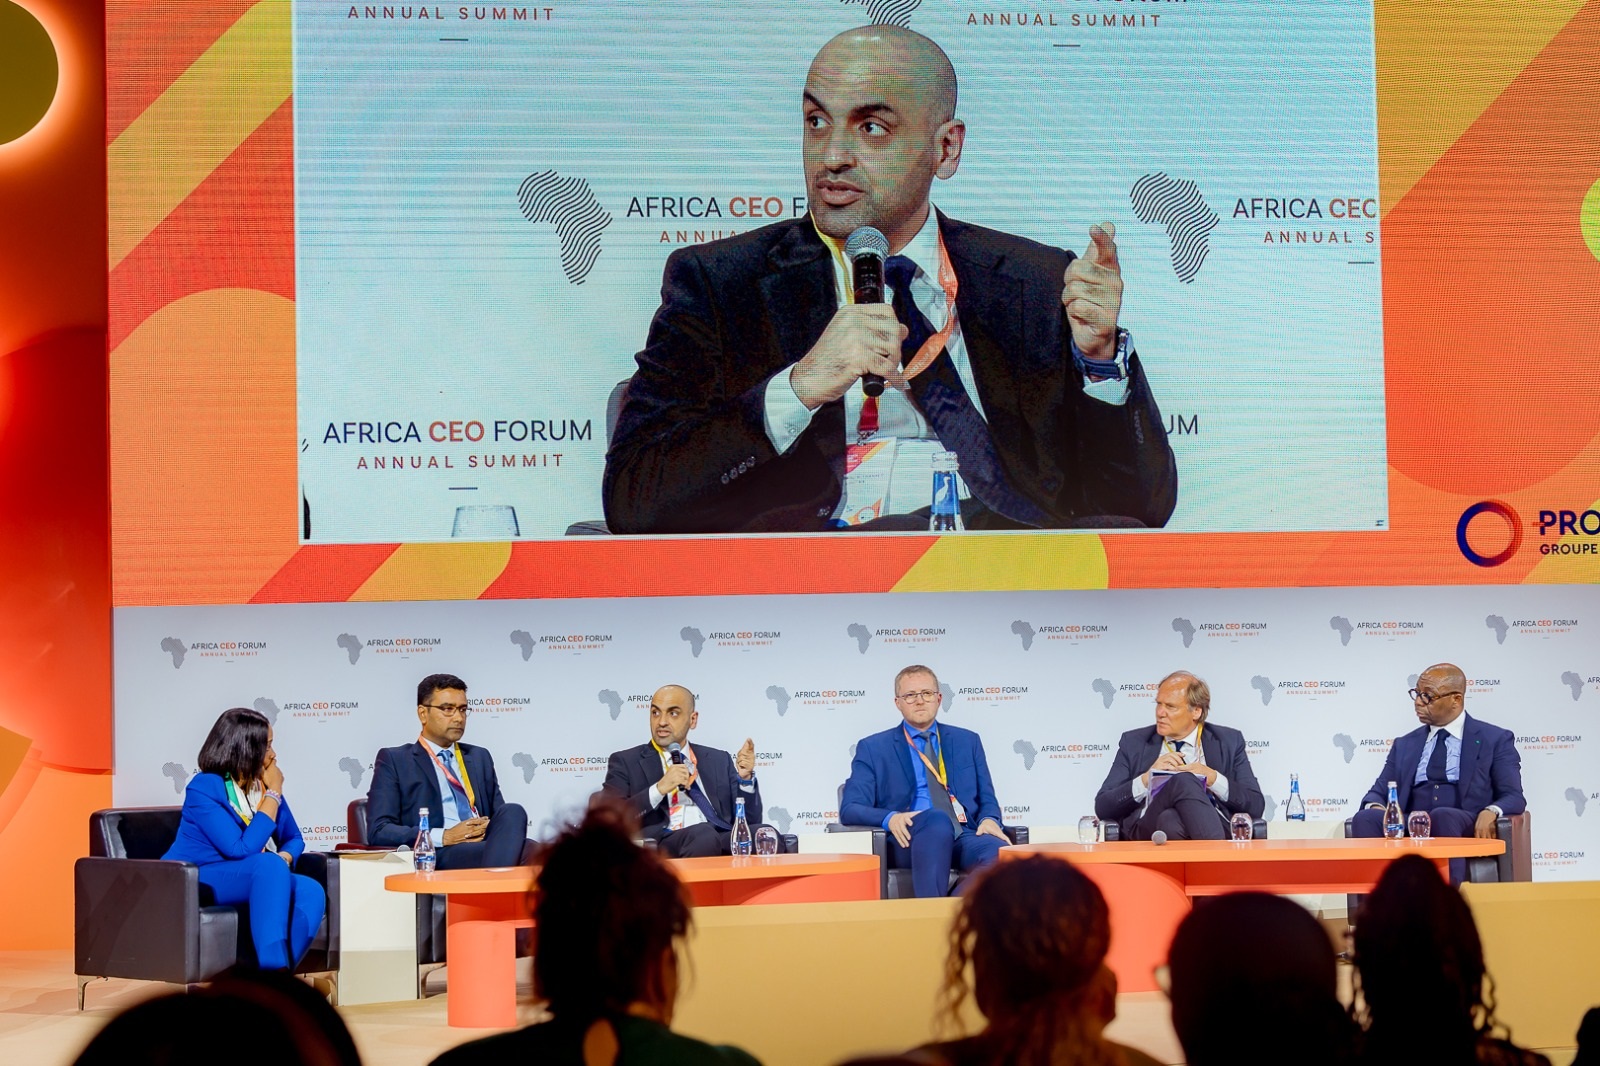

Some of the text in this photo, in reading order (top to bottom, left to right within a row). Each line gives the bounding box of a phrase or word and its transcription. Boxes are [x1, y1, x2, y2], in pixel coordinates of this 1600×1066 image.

[348, 6, 554, 20] ANNUAL SUMMIT
[967, 13, 1160, 27] ANNUAL SUMMIT
[626, 196, 722, 218] AFRICA
[728, 196, 784, 218] CEO
[1232, 198, 1322, 218] AFRICA
[1264, 231, 1352, 243] ANNUAL
[323, 420, 592, 444] AFRICA CEO FORUM
[356, 454, 563, 470] ANNUAL SUMMIT
[1539, 544, 1598, 555] GROUPE
[919, 628, 946, 636] FORUM
[1082, 625, 1108, 633] FORUM
[708, 632, 736, 640] AFRICA
[238, 641, 266, 650] FORUM
[366, 638, 394, 647] AFRICA
[330, 702, 359, 710] FORUM
